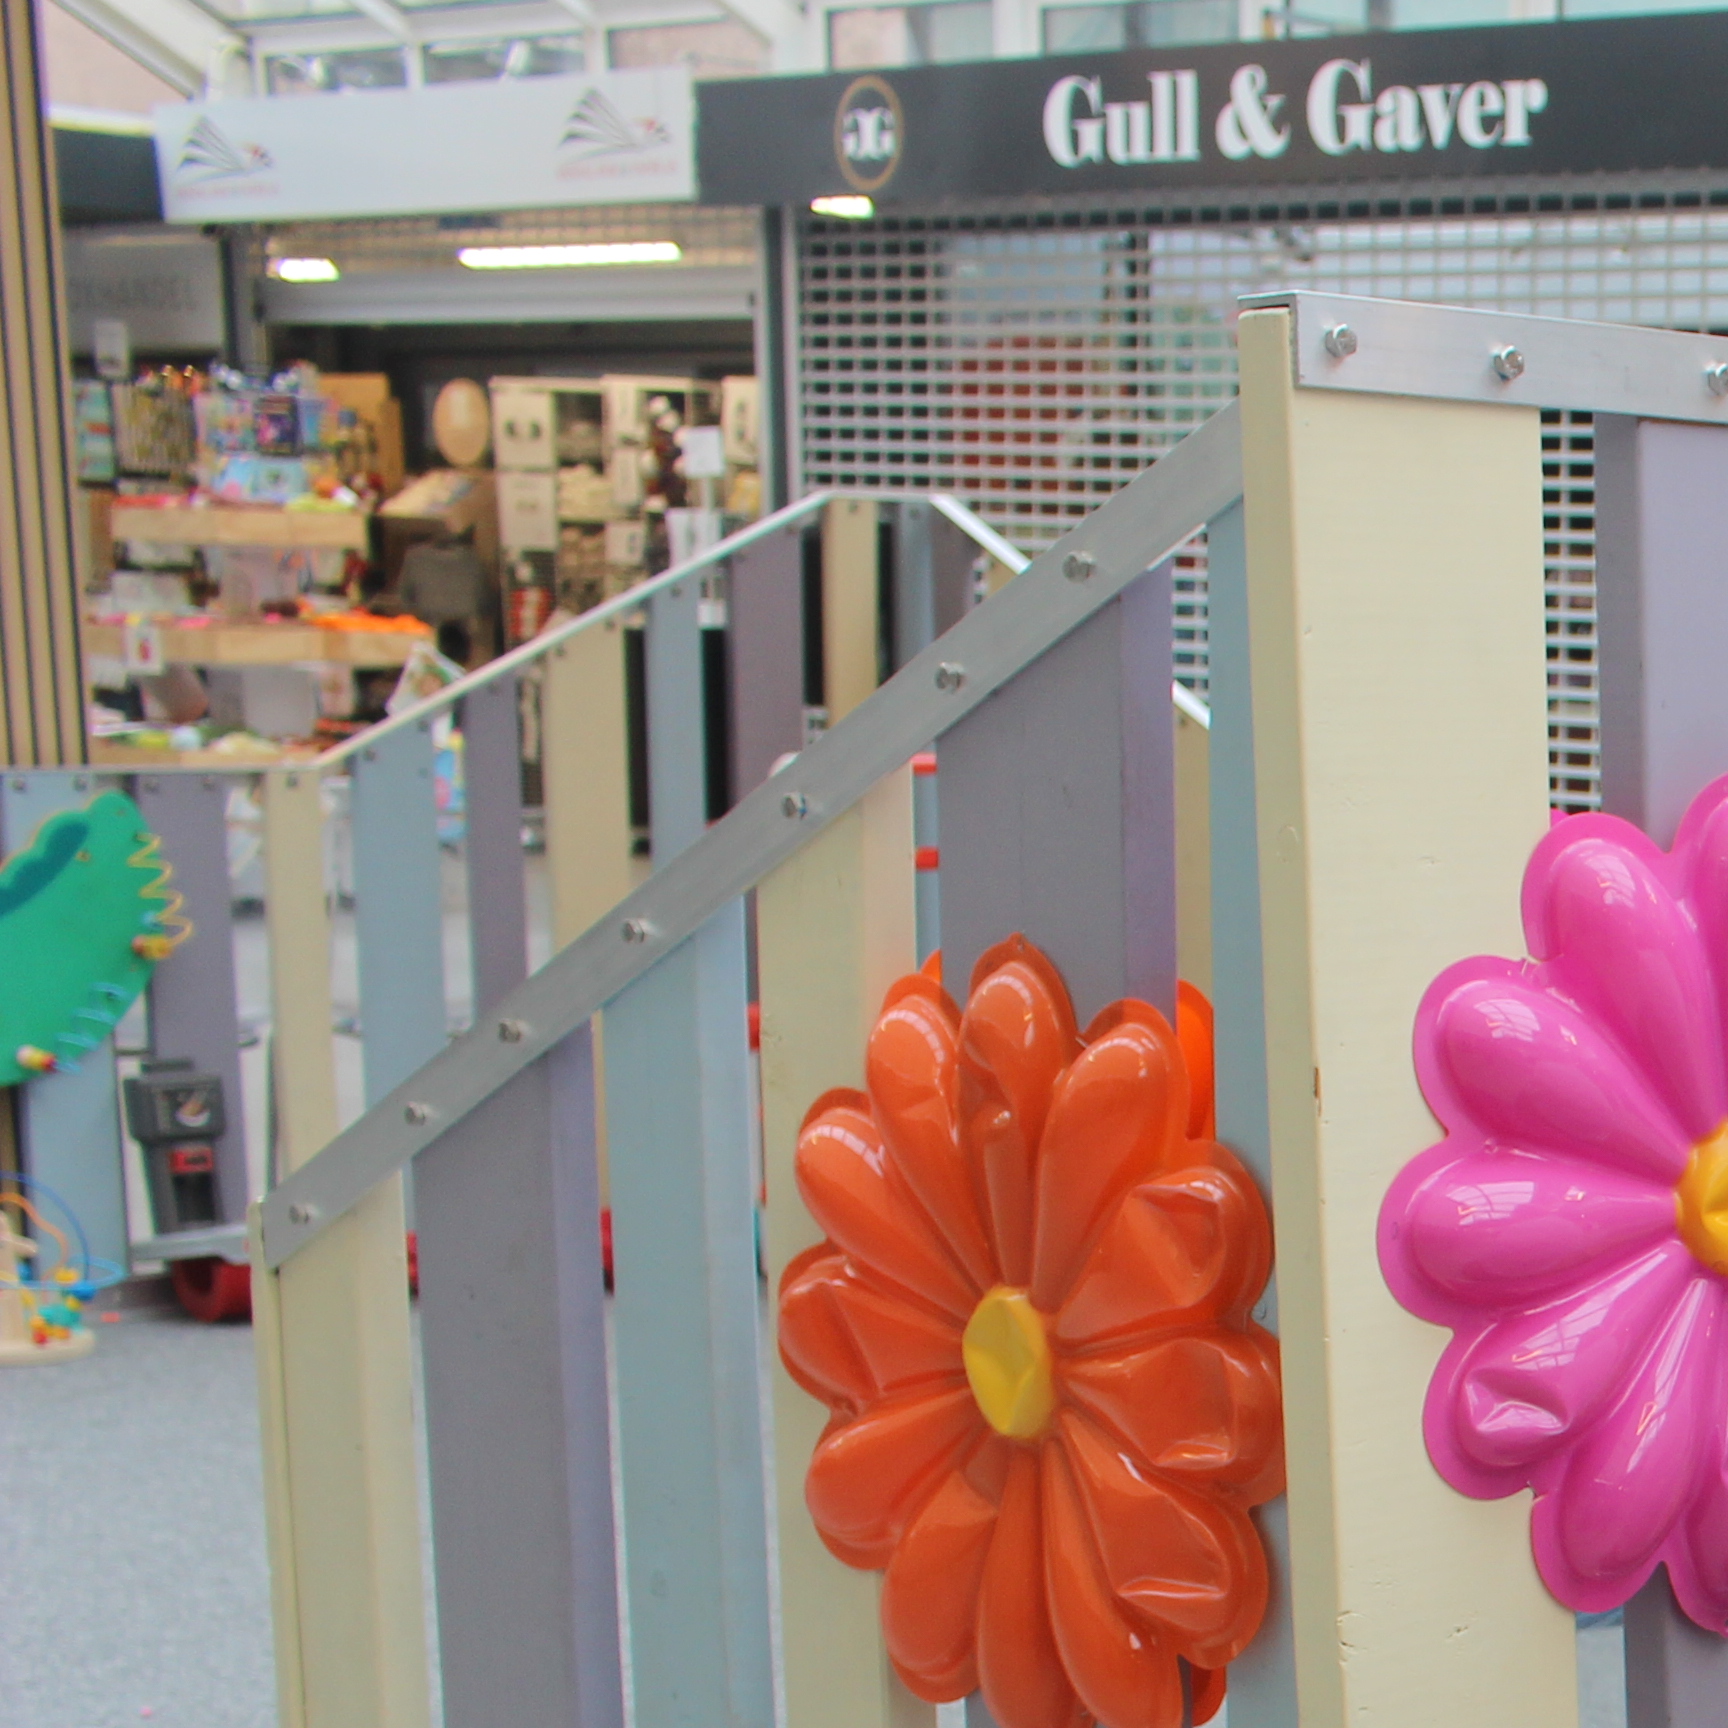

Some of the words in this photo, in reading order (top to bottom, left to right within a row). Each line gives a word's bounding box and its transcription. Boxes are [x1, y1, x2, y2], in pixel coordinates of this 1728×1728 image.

[1042, 69, 1200, 168] Gull
[1215, 63, 1291, 160] &
[1306, 58, 1548, 156] Gaver
